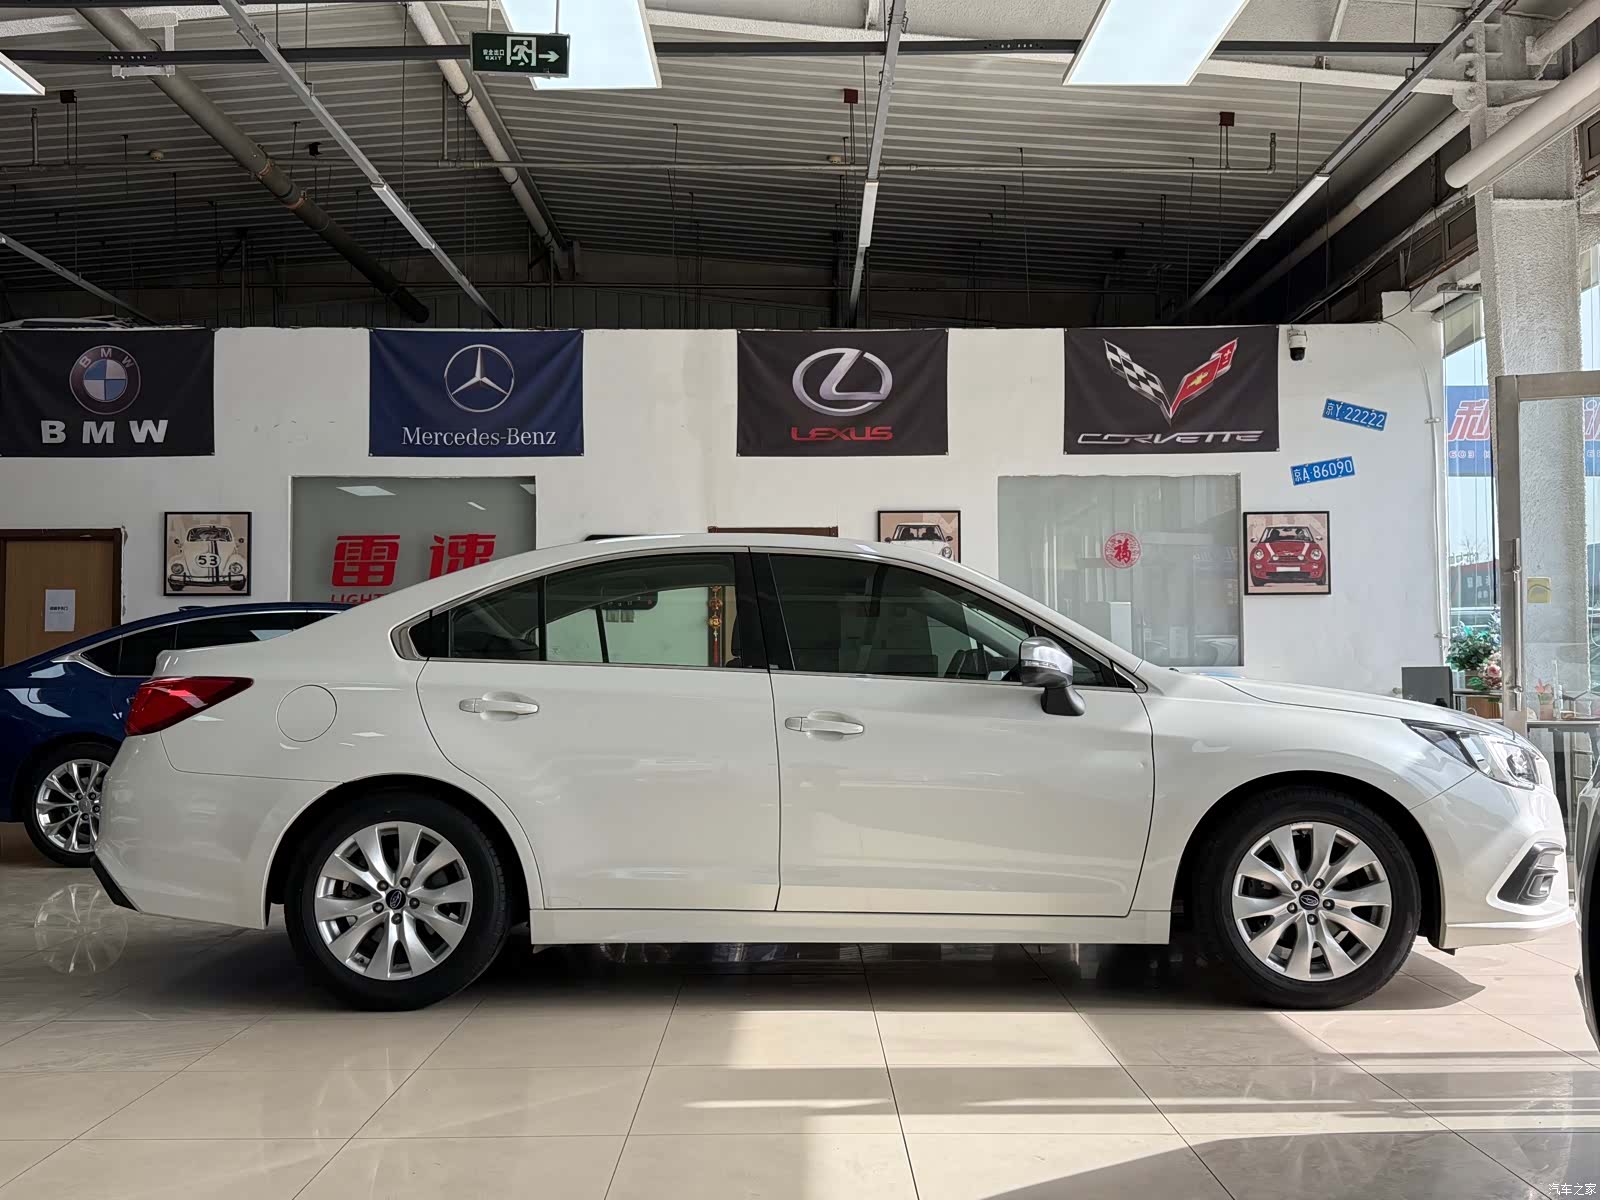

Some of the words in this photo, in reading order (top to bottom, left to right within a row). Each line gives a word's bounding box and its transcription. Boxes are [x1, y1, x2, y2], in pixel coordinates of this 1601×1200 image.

[79, 347, 134, 369] BMW
[41, 419, 168, 444] BMW
[401, 427, 557, 446] Mercedes-Benz
[791, 426, 894, 441] LEXUS
[1077, 430, 1264, 445] CORVETTE
[198, 555, 219, 567] 53
